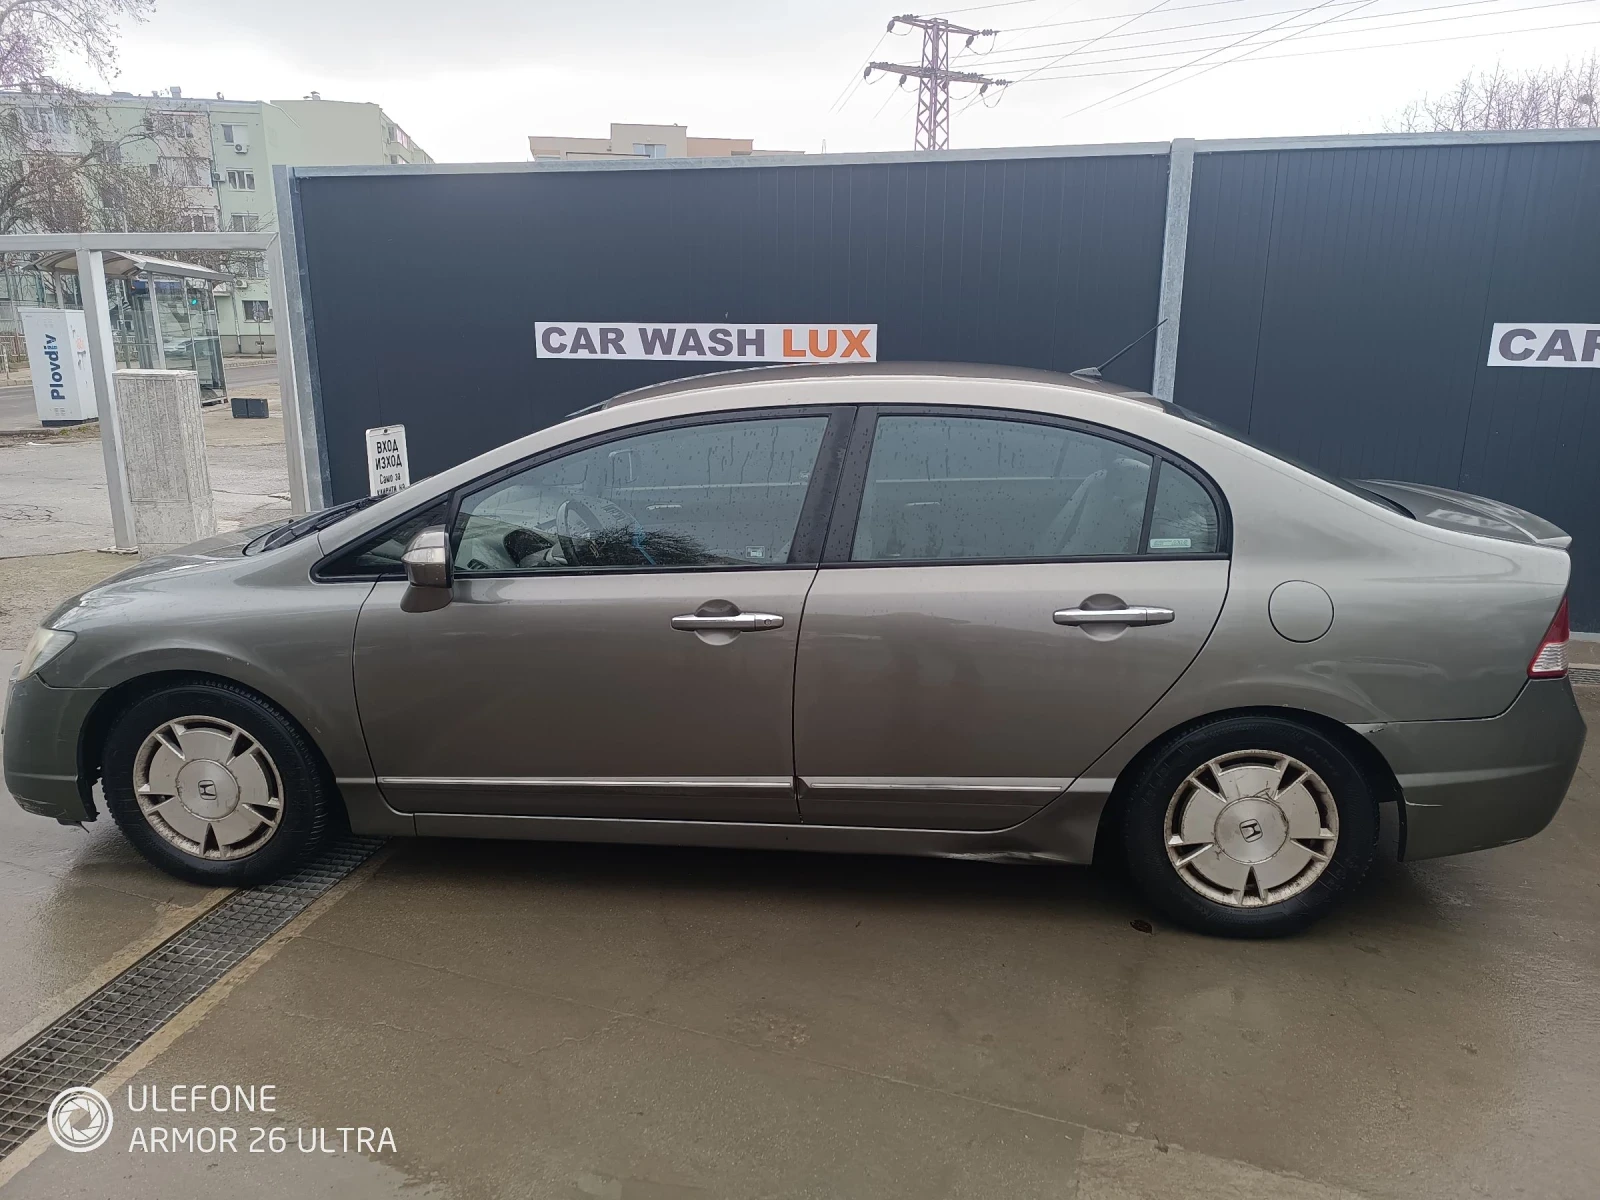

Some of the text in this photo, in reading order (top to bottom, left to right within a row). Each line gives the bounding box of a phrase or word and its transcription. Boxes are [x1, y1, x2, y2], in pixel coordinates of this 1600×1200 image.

[541, 326, 871, 358] CAR WASH LUX
[44, 334, 66, 400] Plovdiv
[376, 439, 399, 454] ВХОД
[375, 454, 402, 471] ИЗХОД
